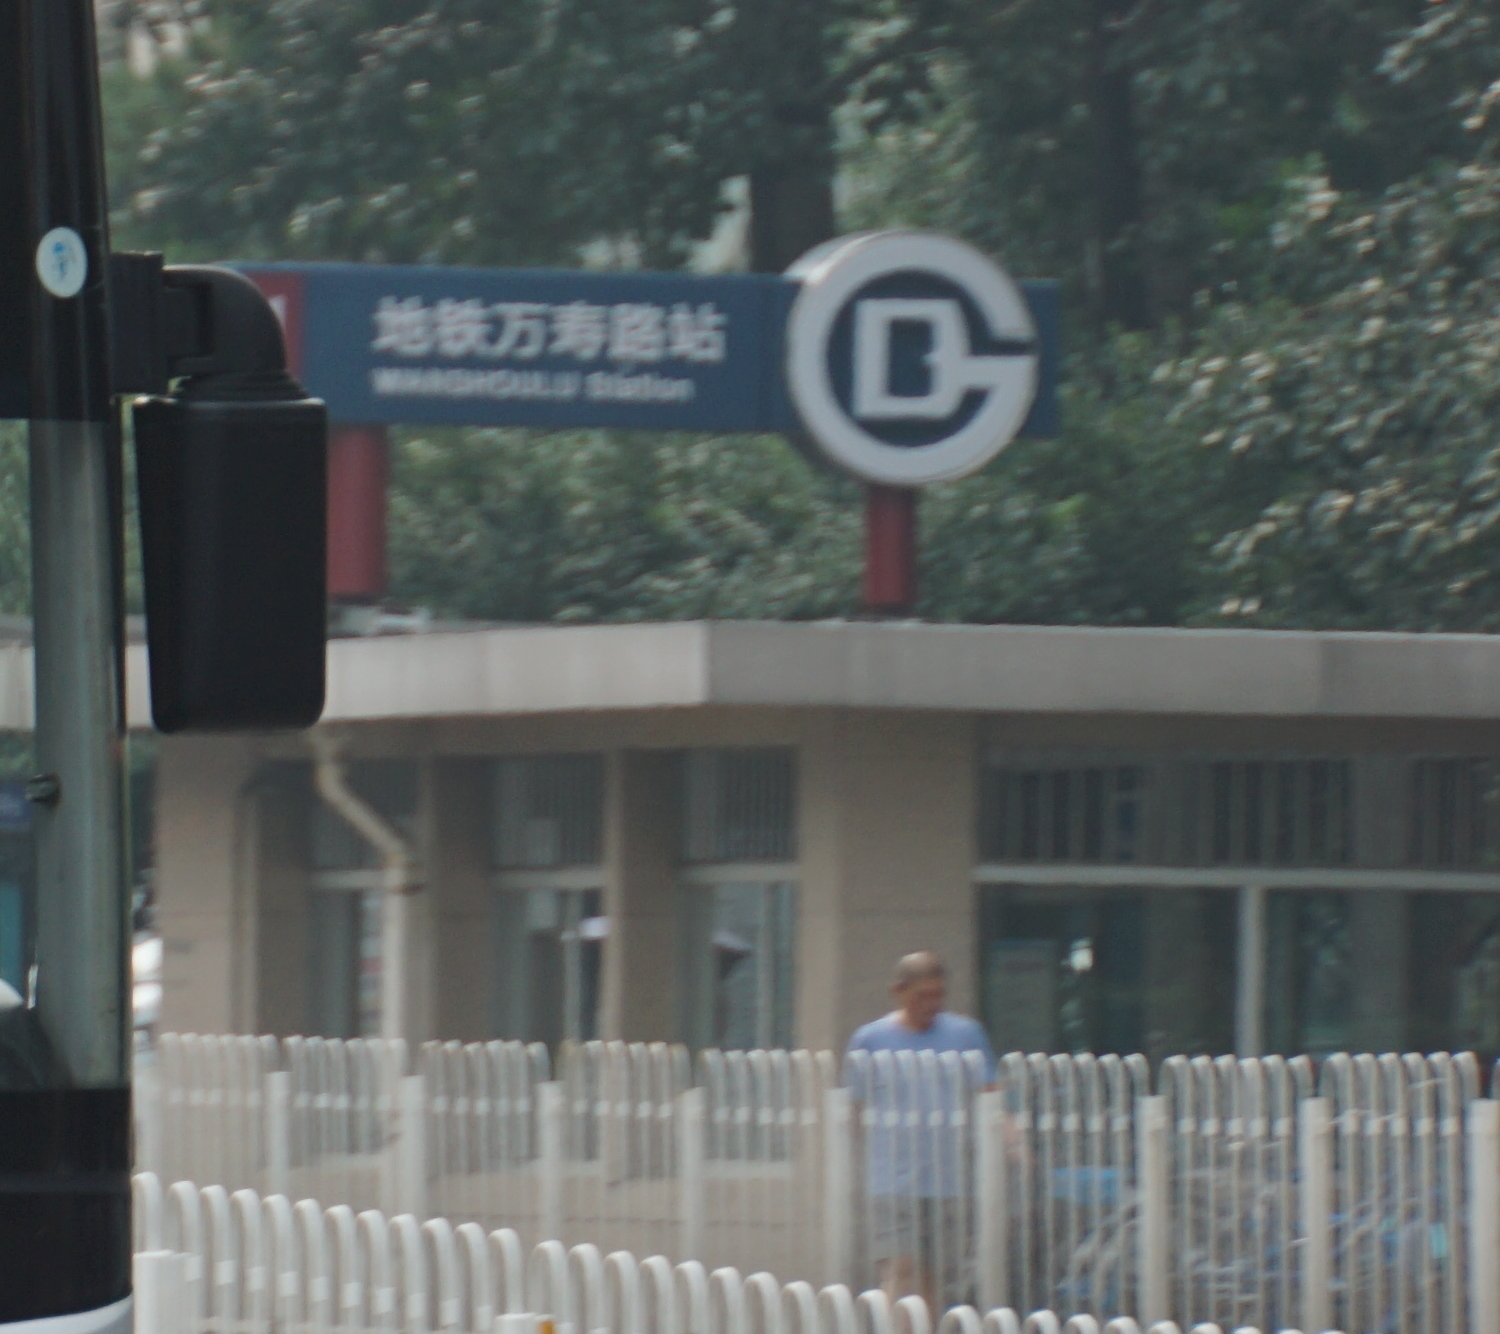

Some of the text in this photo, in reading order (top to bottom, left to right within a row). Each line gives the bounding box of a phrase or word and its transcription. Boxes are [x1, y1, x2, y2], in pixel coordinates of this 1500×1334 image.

[372, 295, 727, 364] 地铁万寿路站
